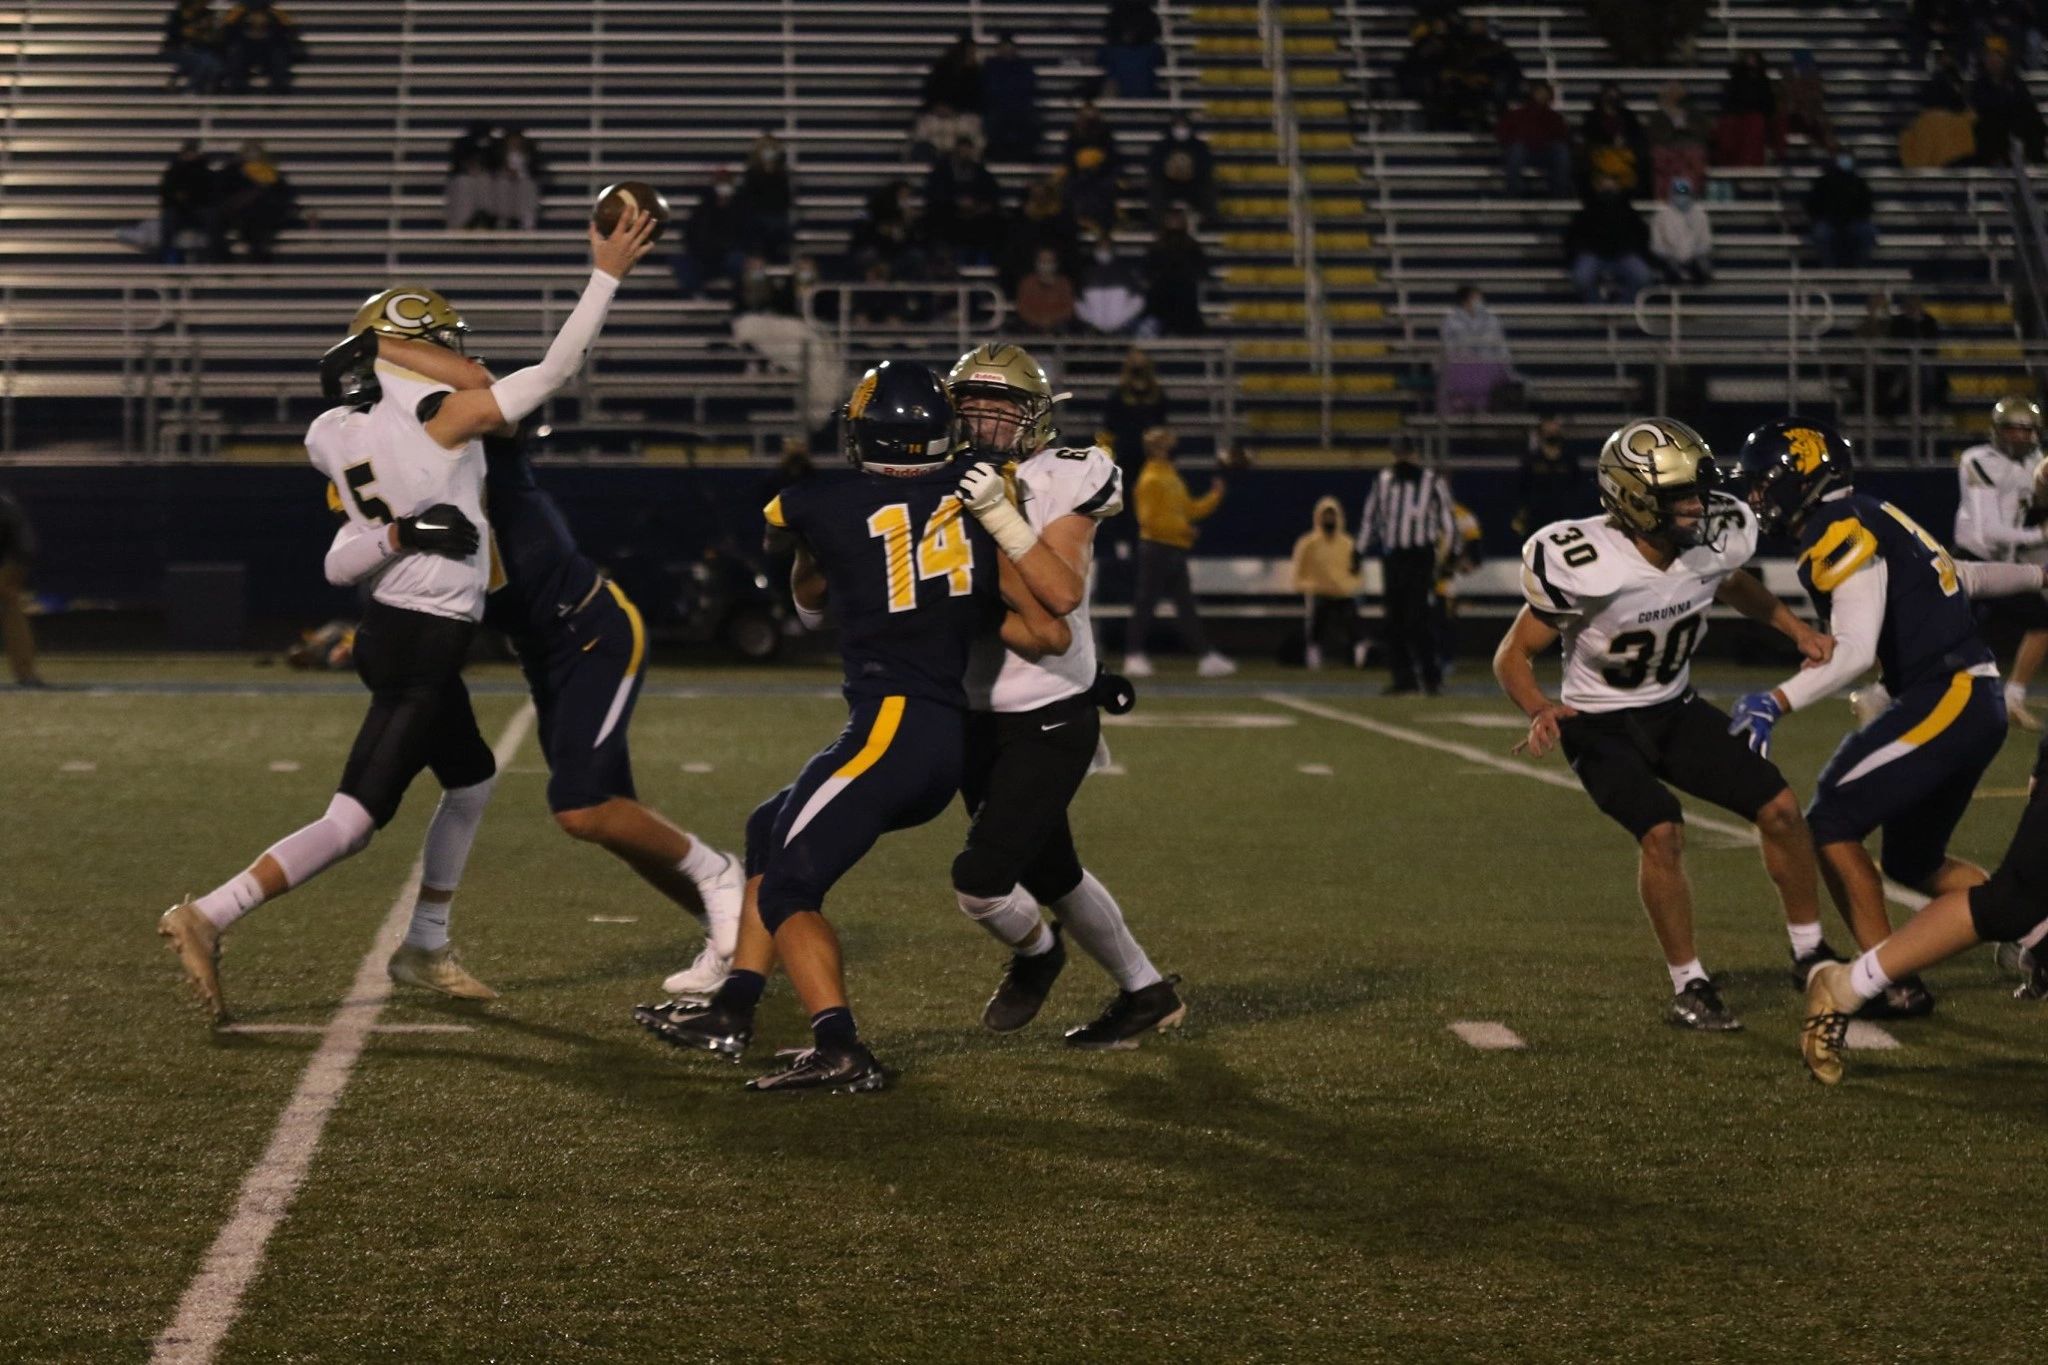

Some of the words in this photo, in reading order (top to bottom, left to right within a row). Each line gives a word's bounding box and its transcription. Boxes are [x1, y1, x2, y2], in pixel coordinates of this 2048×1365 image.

[866, 495, 976, 614] 14
[1550, 527, 1598, 568] 30
[1638, 601, 1692, 624] CORUNNA
[1603, 614, 1701, 690] 30
